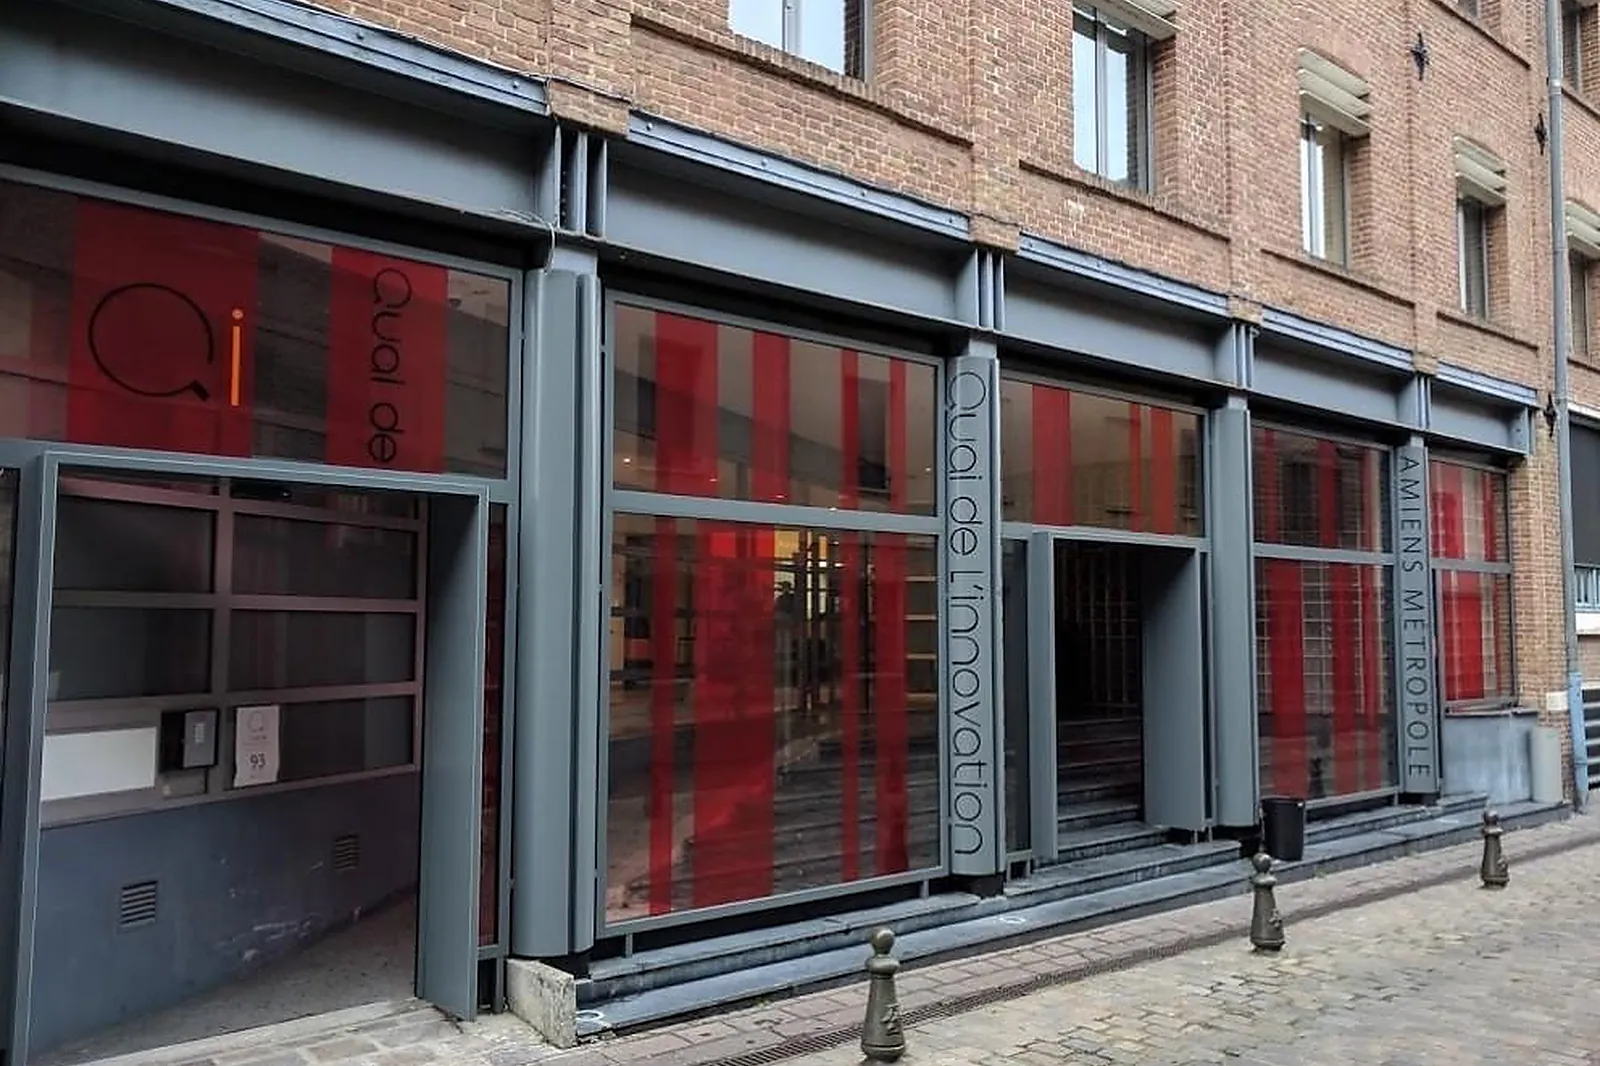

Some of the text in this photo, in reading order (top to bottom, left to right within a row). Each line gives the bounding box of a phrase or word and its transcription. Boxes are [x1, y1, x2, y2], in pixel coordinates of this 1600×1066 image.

[368, 267, 412, 463] Quai de
[949, 371, 988, 855] Quai de L'innovation
[1399, 455, 1430, 777] AMIENS METROPOLE
[250, 753, 266, 769] 93
